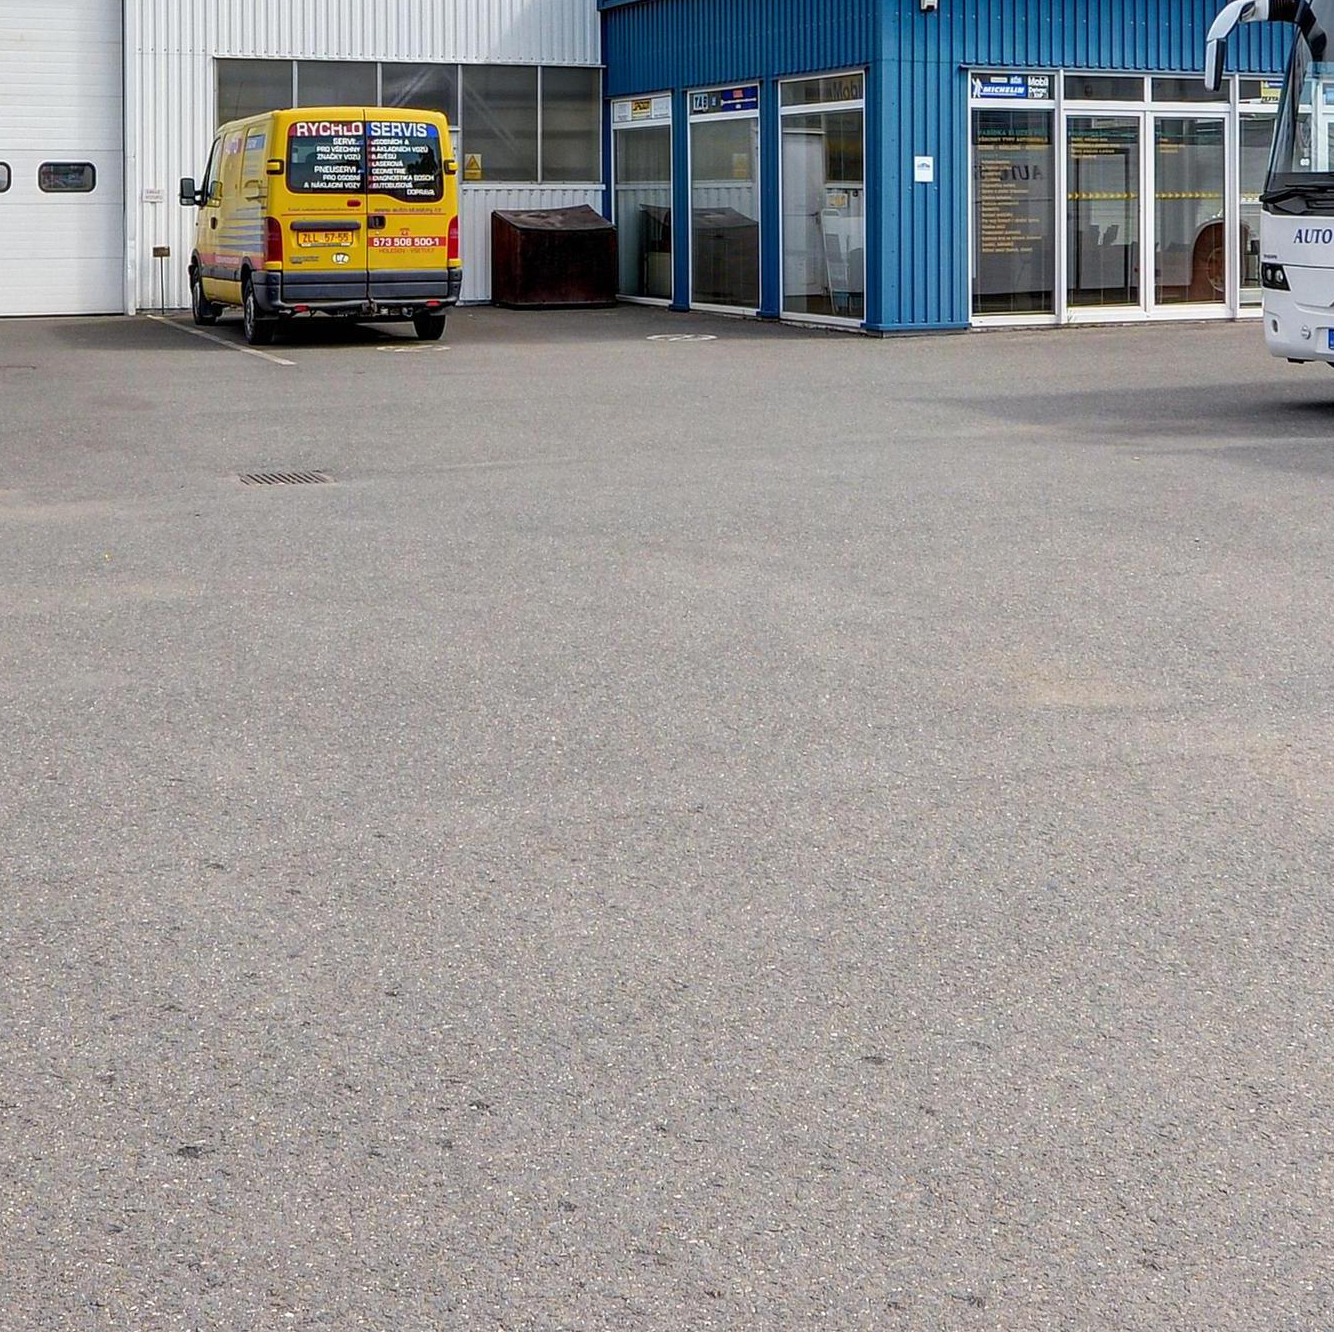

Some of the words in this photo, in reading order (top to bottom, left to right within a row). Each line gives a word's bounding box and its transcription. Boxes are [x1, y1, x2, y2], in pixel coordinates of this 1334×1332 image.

[982, 86, 1025, 94] MICHELIN
[296, 122, 363, 137] RYCHLO
[370, 123, 427, 137] SERVIS
[373, 237, 391, 247] 573
[1293, 228, 1333, 244] AUTO
